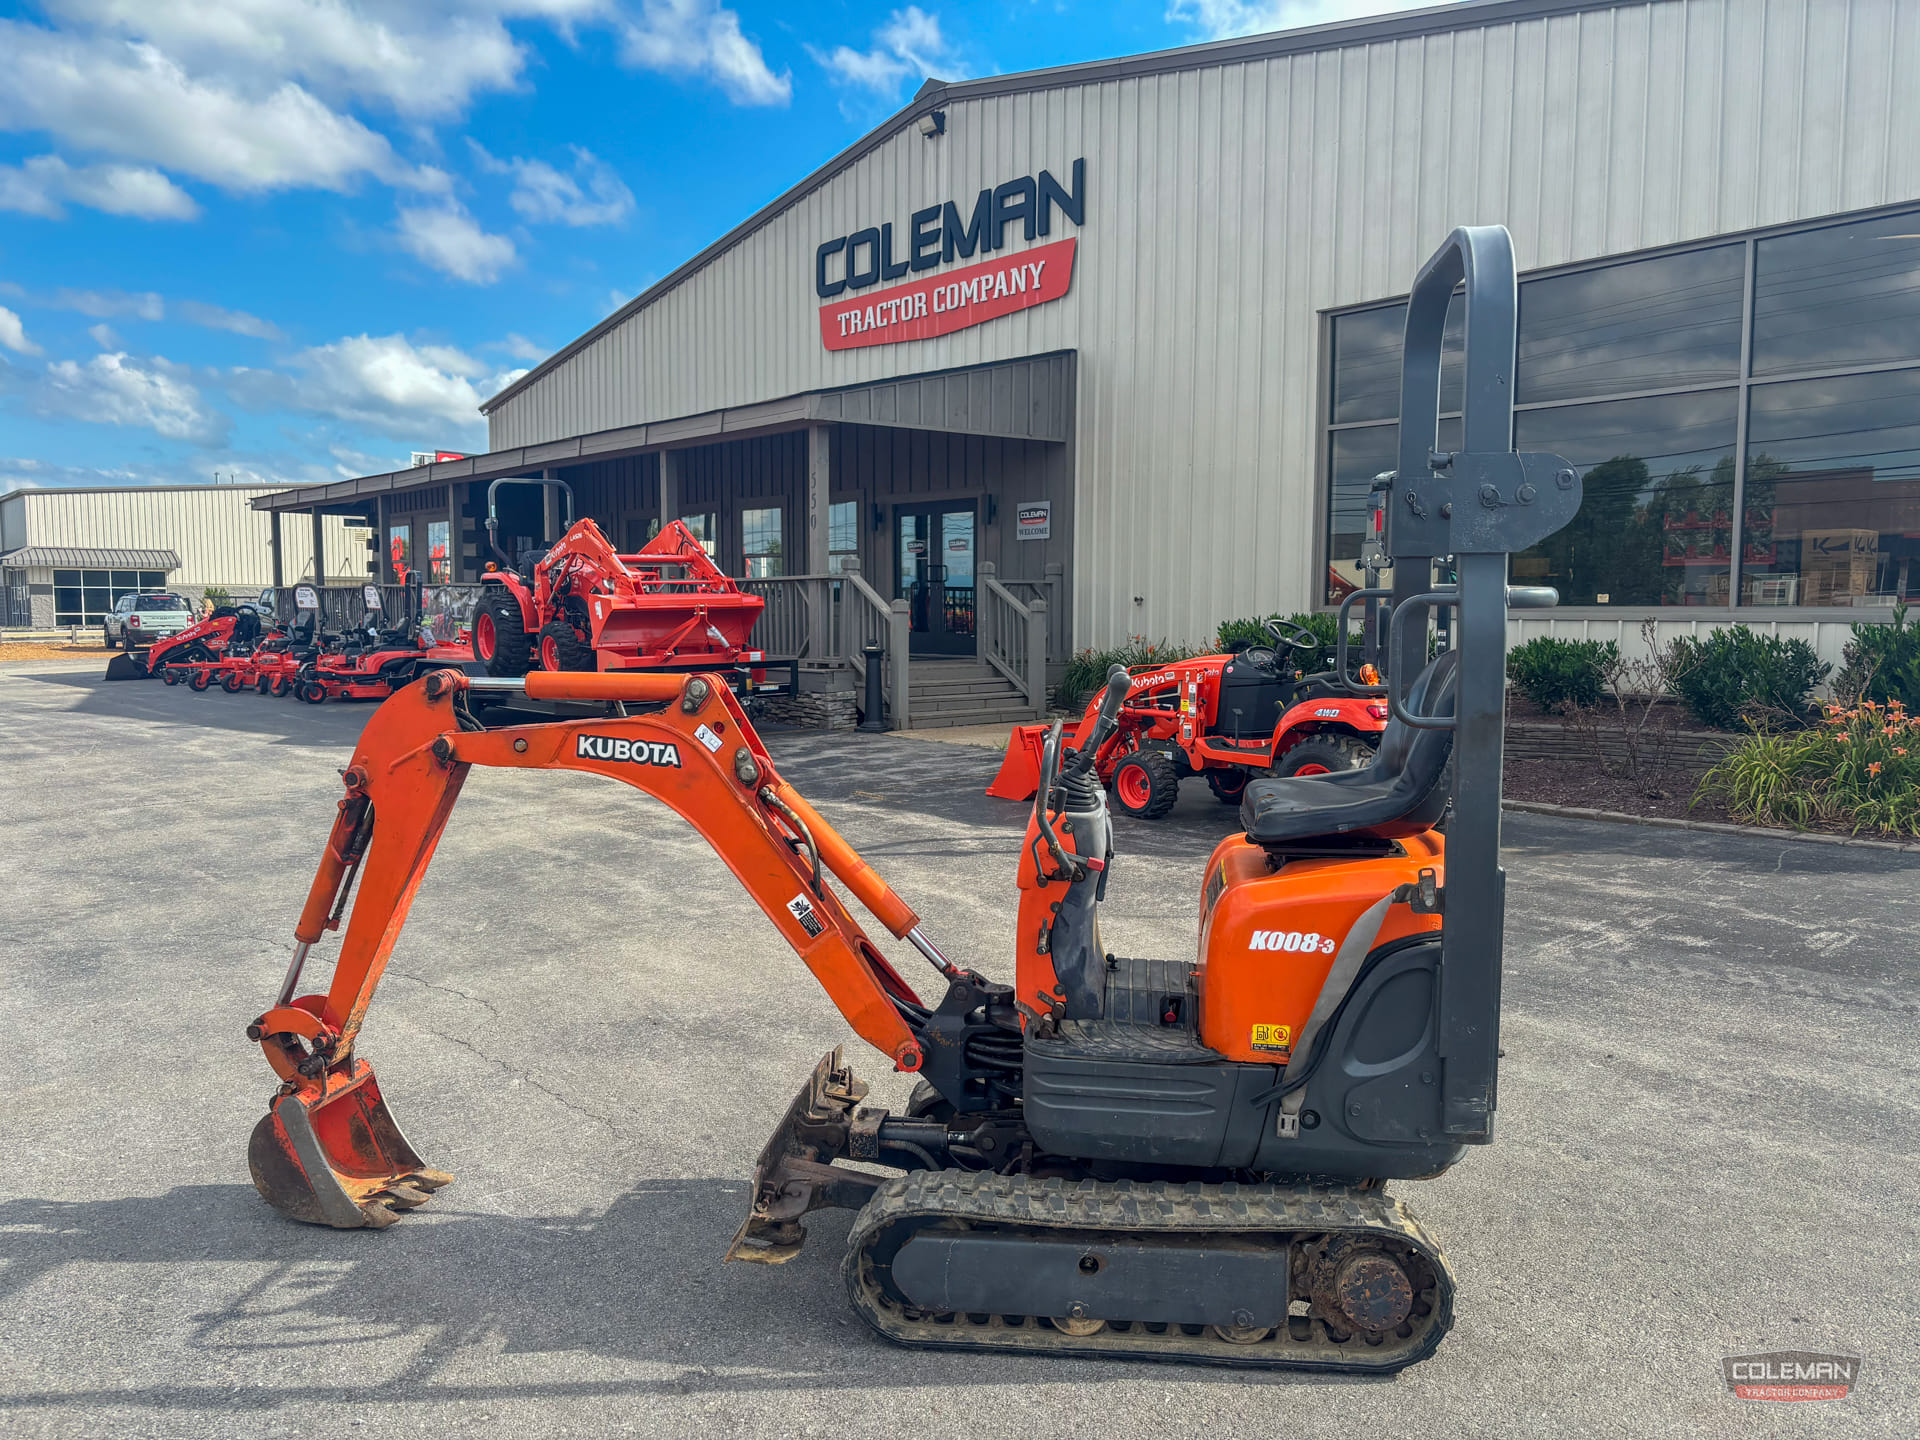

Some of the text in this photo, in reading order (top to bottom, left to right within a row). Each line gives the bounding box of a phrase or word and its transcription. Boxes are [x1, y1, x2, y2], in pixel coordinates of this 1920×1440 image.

[816, 157, 1085, 298] COLEMAN
[837, 260, 1046, 337] TRACTOR COMPANY
[1020, 510, 1047, 519] COLEMAN
[1019, 527, 1049, 536] WELCOME
[1131, 674, 1165, 688] Kubota
[1314, 708, 1340, 718] 4WD
[577, 735, 680, 767] KUBOTA
[1248, 930, 1336, 954] K008-3
